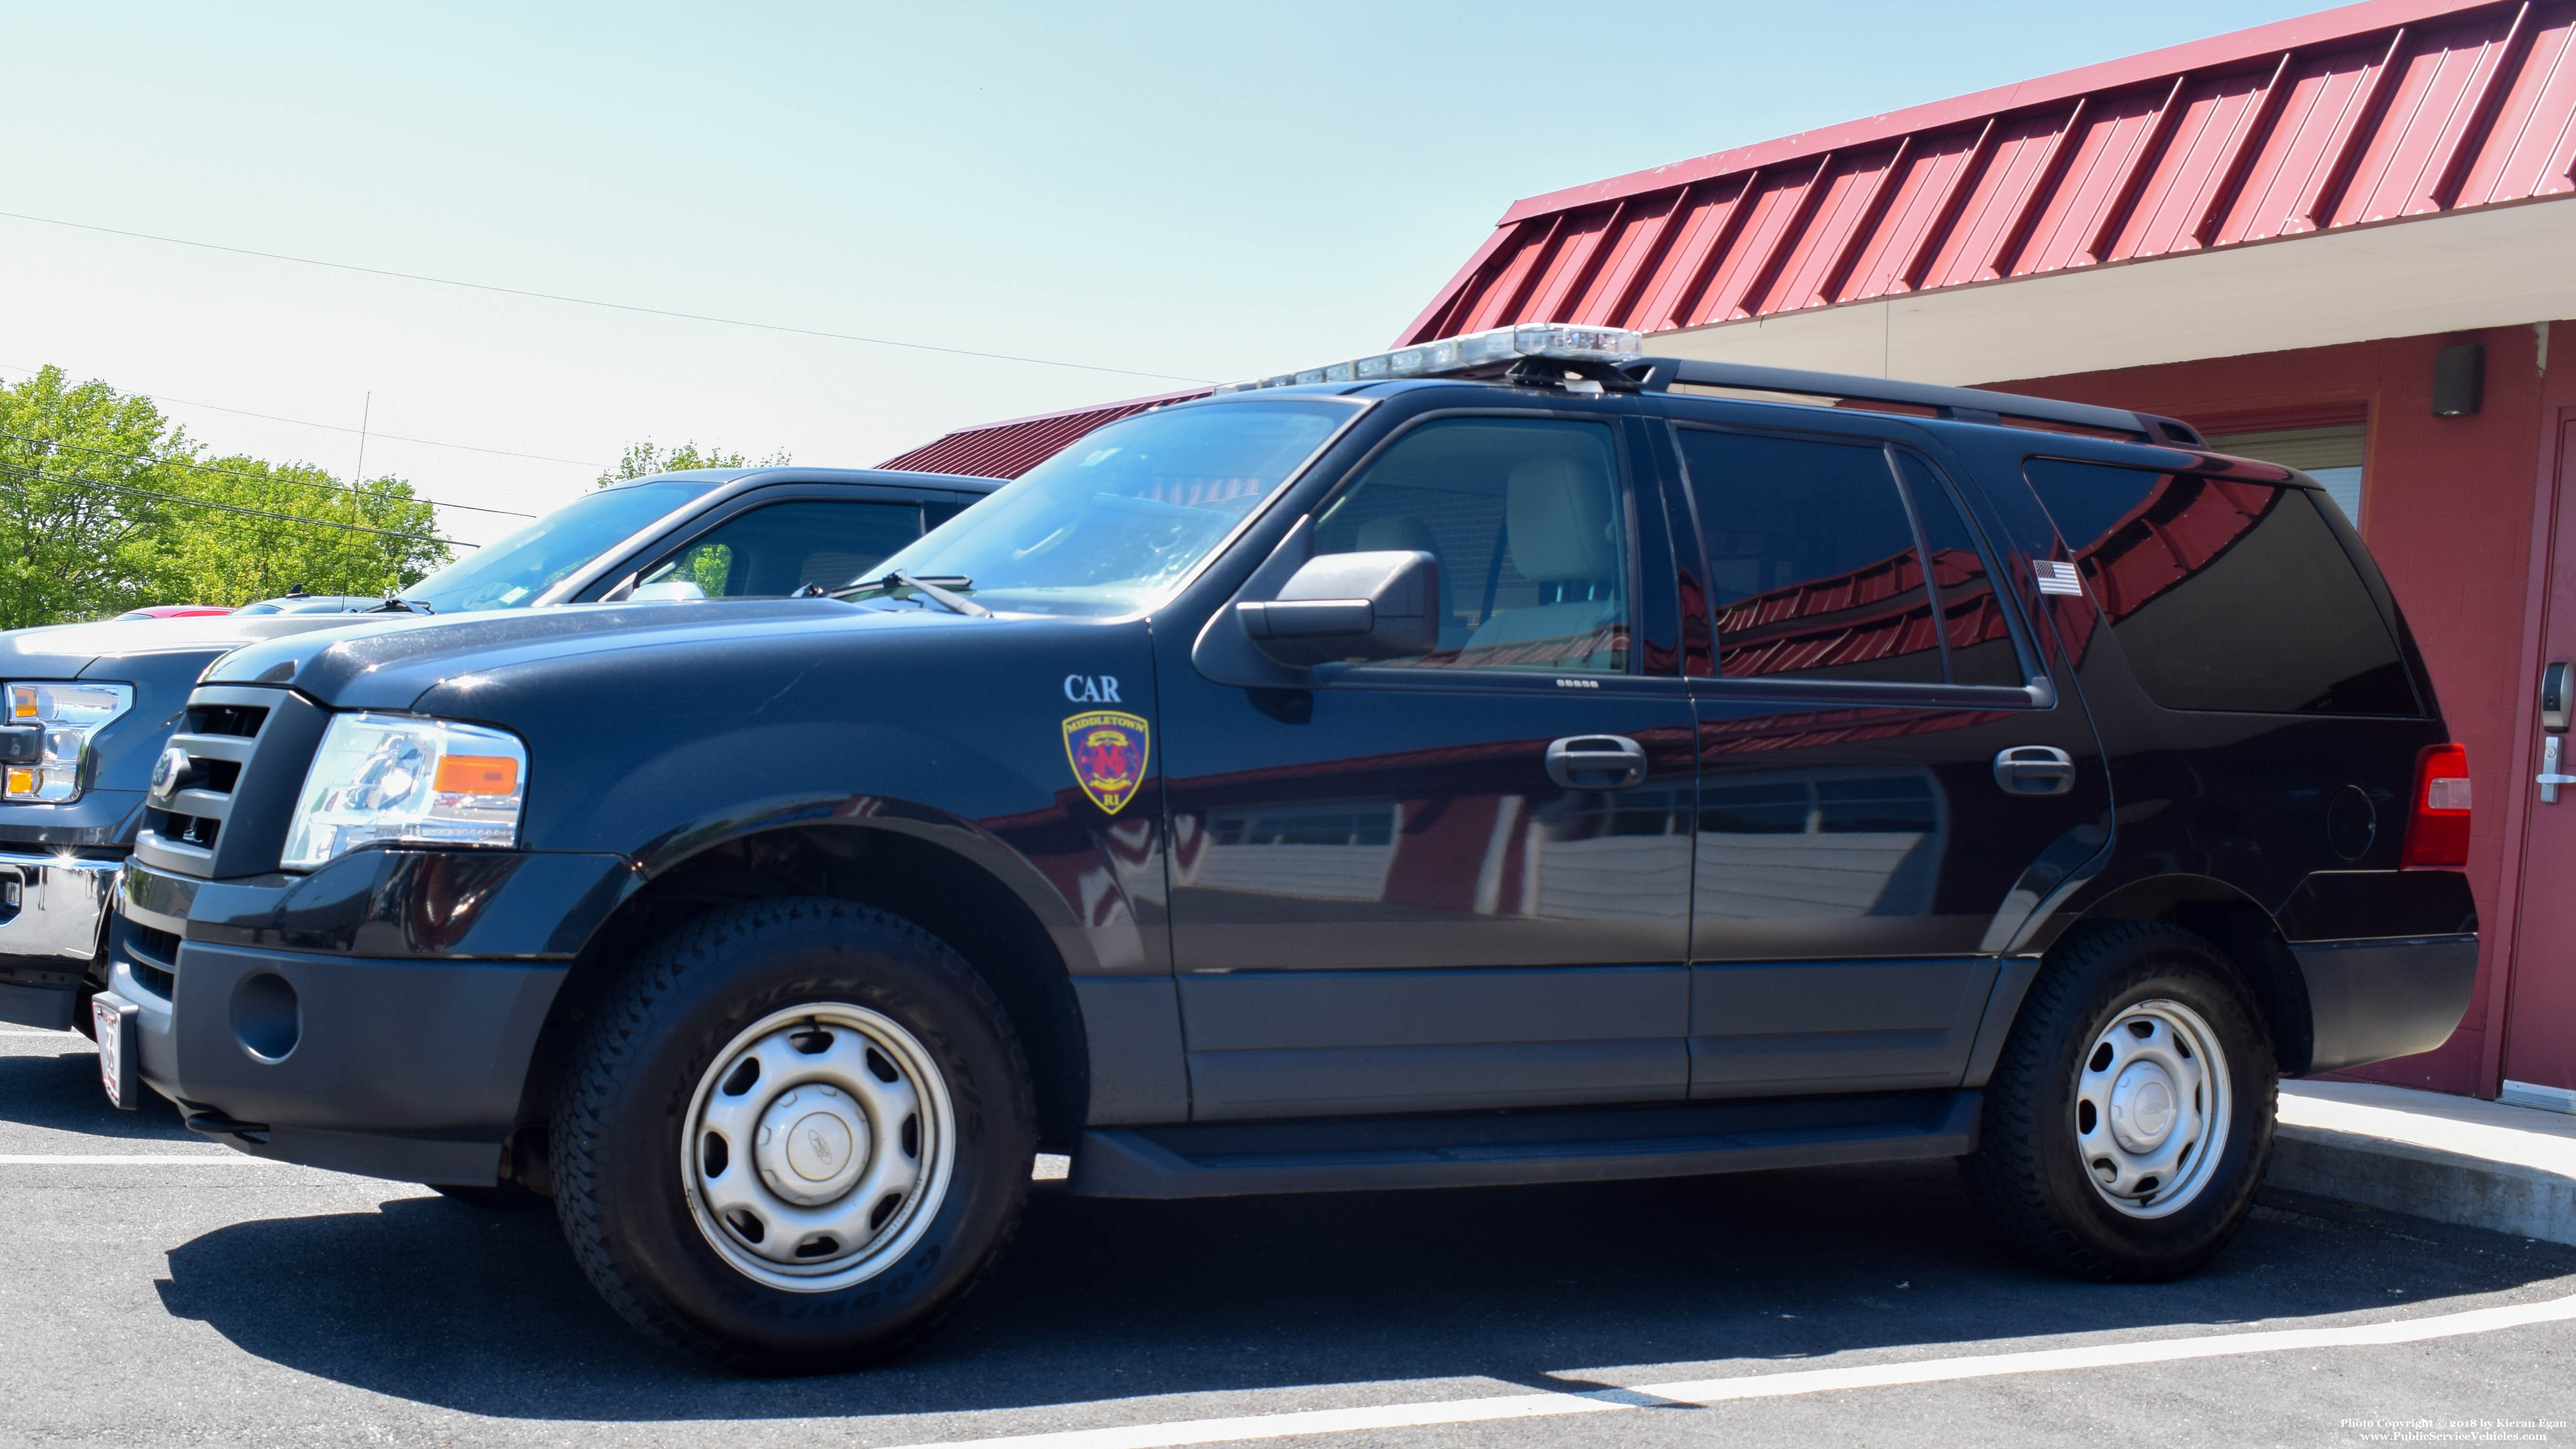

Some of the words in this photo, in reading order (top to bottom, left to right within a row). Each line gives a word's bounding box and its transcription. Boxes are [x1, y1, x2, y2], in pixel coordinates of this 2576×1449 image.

[1064, 674, 1122, 703] CAR
[1066, 715, 1145, 733] MIDDLETOWN
[1103, 794, 1120, 806] RI
